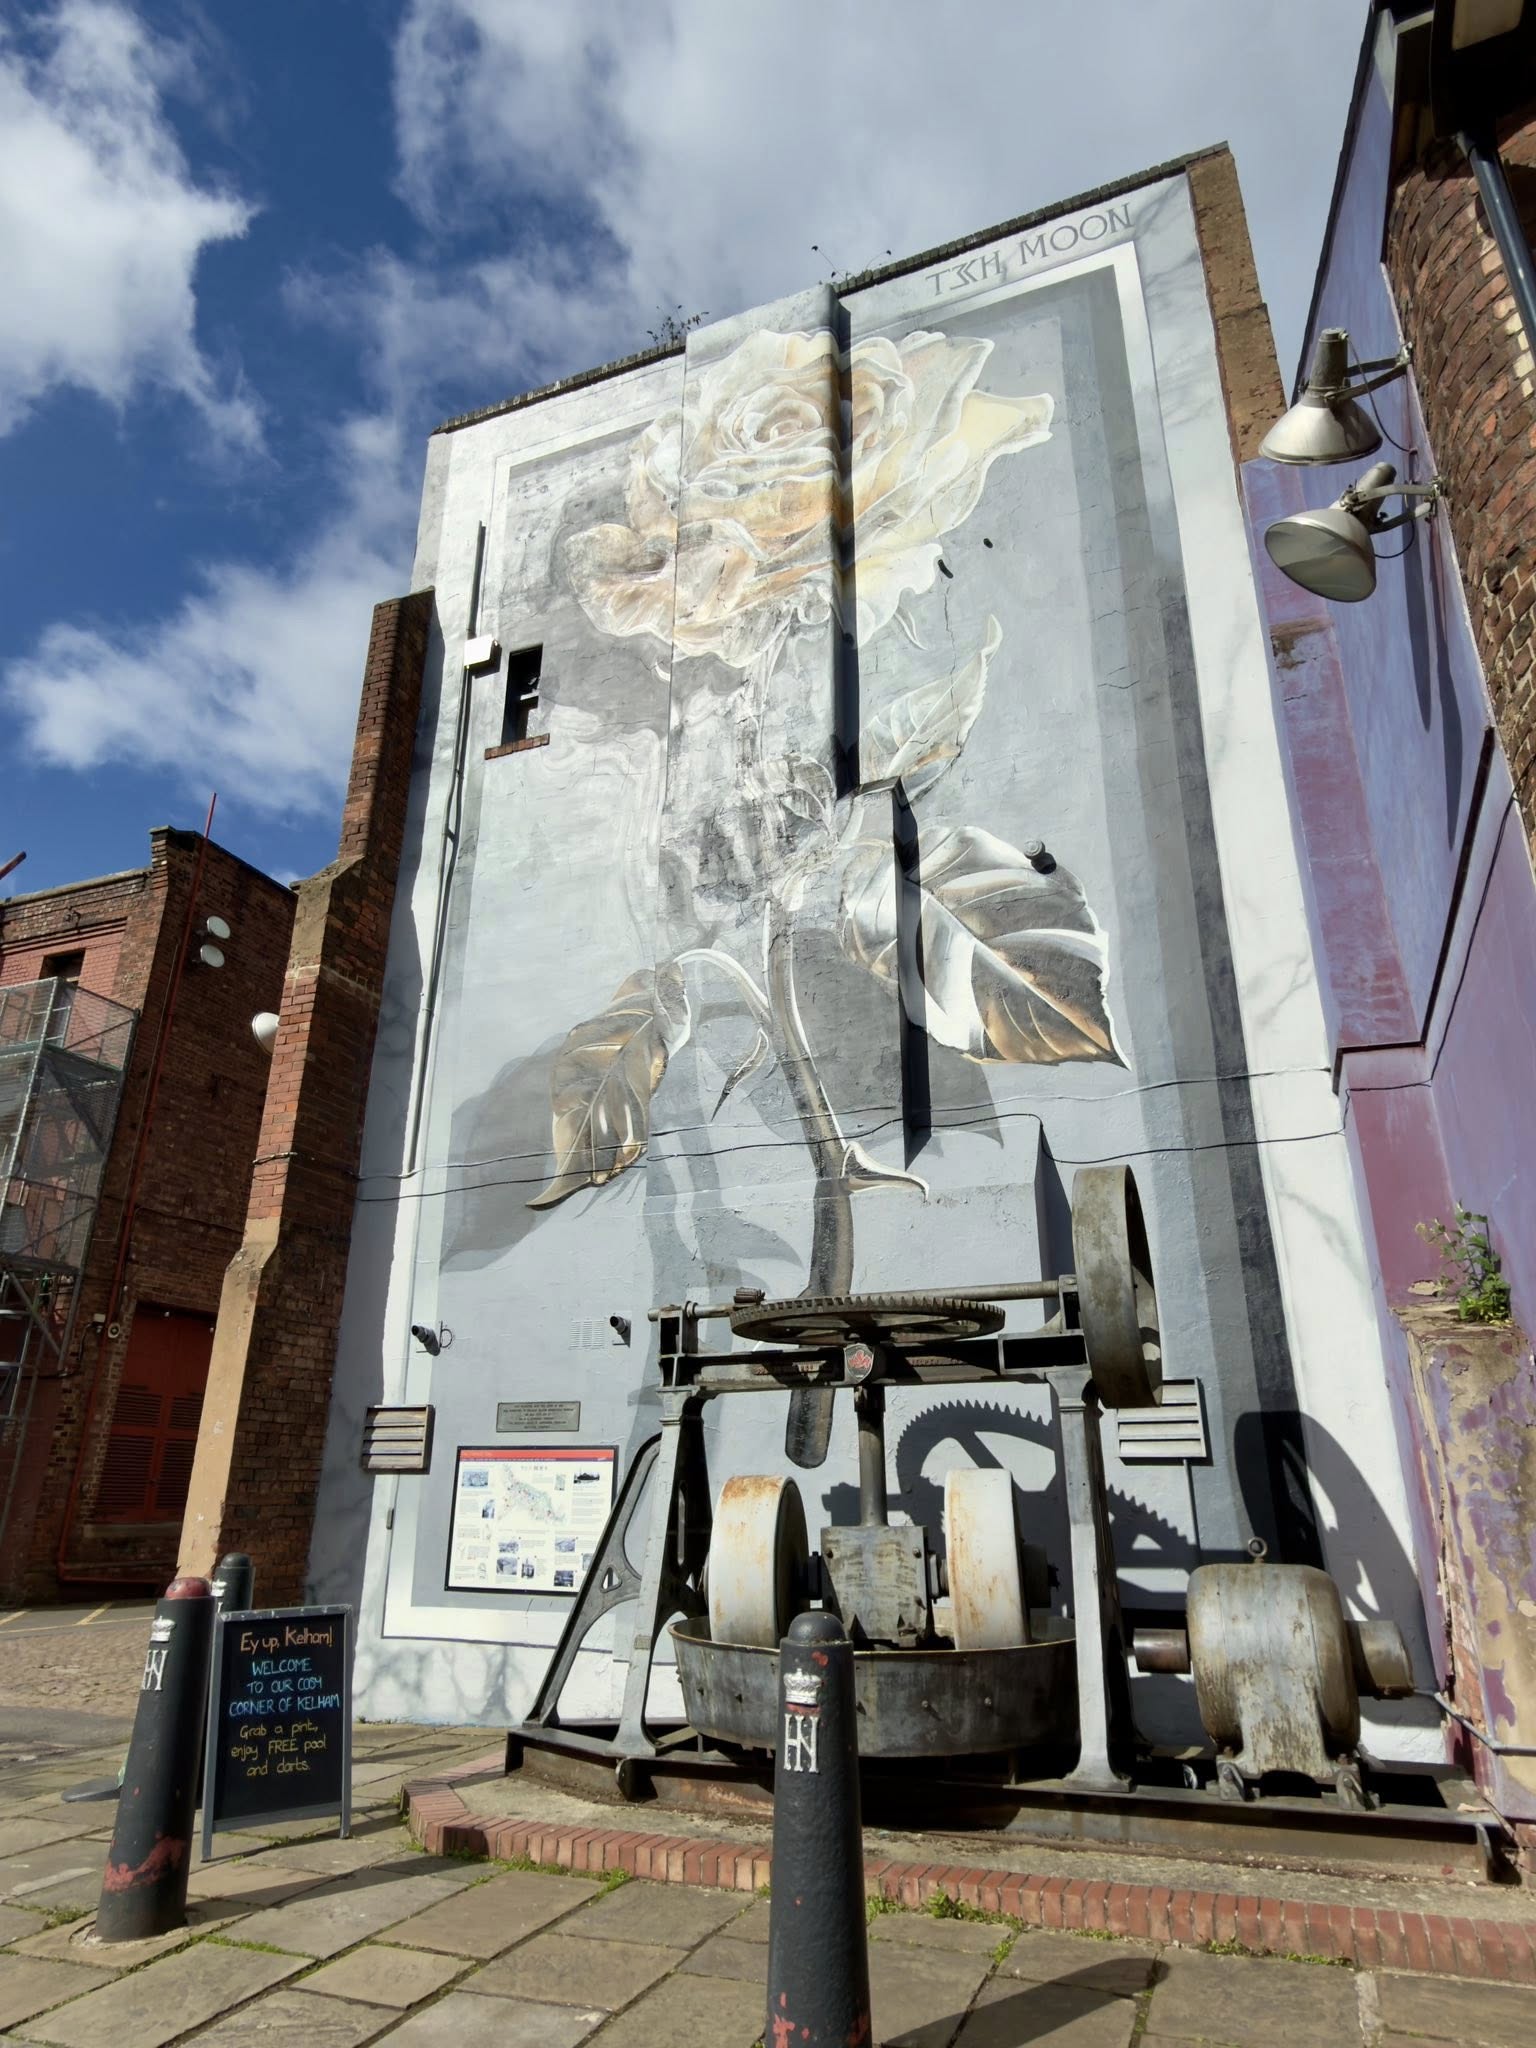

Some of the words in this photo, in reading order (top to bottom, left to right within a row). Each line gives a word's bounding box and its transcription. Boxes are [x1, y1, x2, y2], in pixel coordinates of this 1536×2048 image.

[1018, 203, 1134, 265] MOON
[240, 1632, 258, 1654] Ey
[262, 1637, 280, 1654] up,
[285, 1626, 333, 1648] Kelham!
[252, 1657, 312, 1676] WELCOME
[246, 1681, 264, 1695] TO
[271, 1679, 294, 1693] OUR
[229, 1699, 275, 1718] CORNER
[278, 1696, 292, 1712] OF
[297, 1693, 340, 1712] KELHAM
[240, 1724, 267, 1740] Grab
[274, 1726, 283, 1734] a
[230, 1744, 259, 1762] enjoy
[268, 1738, 299, 1755] FREE
[304, 1734, 327, 1754] pool
[246, 1759, 268, 1777] and
